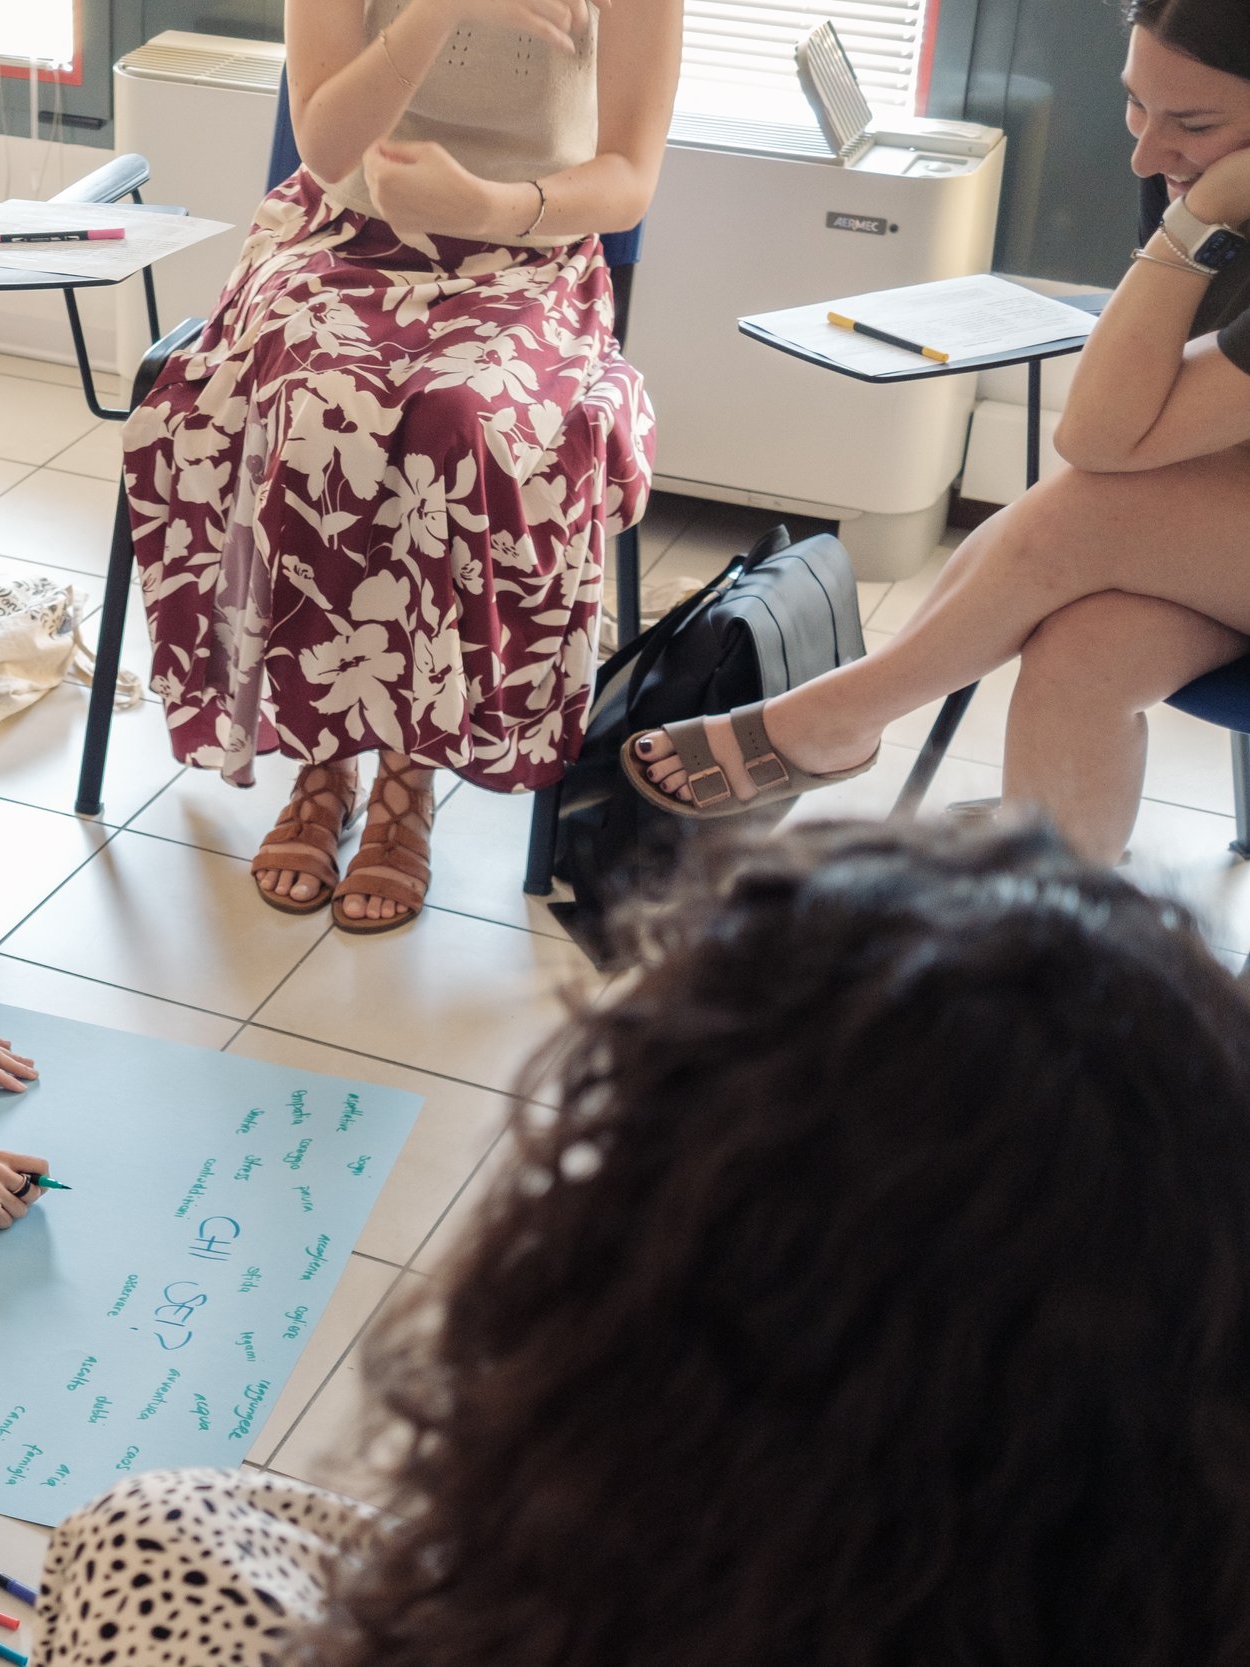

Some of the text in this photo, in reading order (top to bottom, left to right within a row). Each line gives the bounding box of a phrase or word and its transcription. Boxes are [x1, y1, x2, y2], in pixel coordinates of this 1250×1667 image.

[833, 217, 879, 232] AERMEC
[282, 1139, 313, 1170] coraggio
[175, 1158, 216, 1219] contraddizioni
[292, 1186, 313, 1212] paura
[107, 1274, 138, 1316] osservare
[130, 1215, 241, 1351] CHI SEI?
[282, 1306, 309, 1339] cogliere
[236, 1332, 256, 1362] legami
[137, 1368, 180, 1420] avventura
[88, 1396, 112, 1426] dubbi
[5, 1444, 43, 1486] famiglia
[40, 1464, 70, 1487] aria
